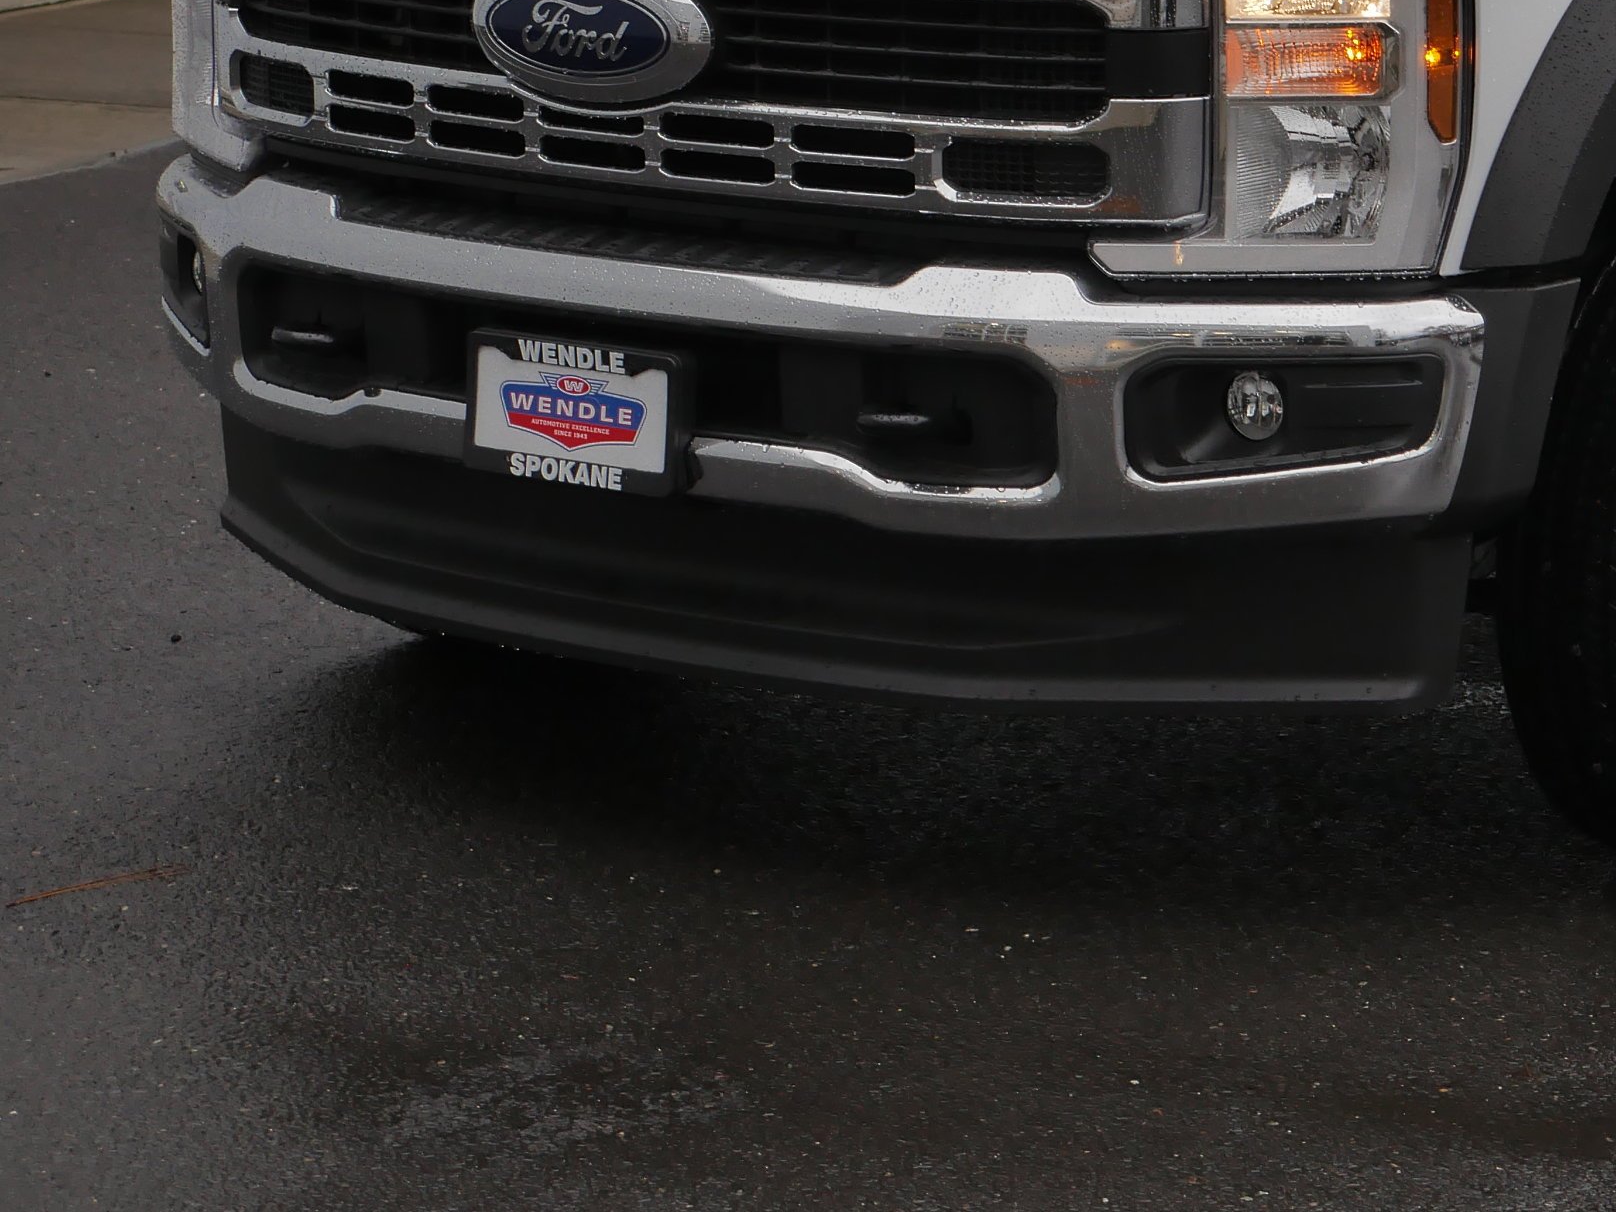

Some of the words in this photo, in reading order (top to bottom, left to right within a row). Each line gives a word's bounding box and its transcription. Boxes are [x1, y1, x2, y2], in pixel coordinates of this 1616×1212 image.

[517, 338, 626, 376] WENDLE
[510, 392, 633, 427] WENDLE
[530, 417, 571, 430] AUTOMOTIVE
[571, 423, 611, 436] EXCELLENCE
[553, 429, 573, 438] SINCE
[509, 452, 623, 491] SPOKANE
